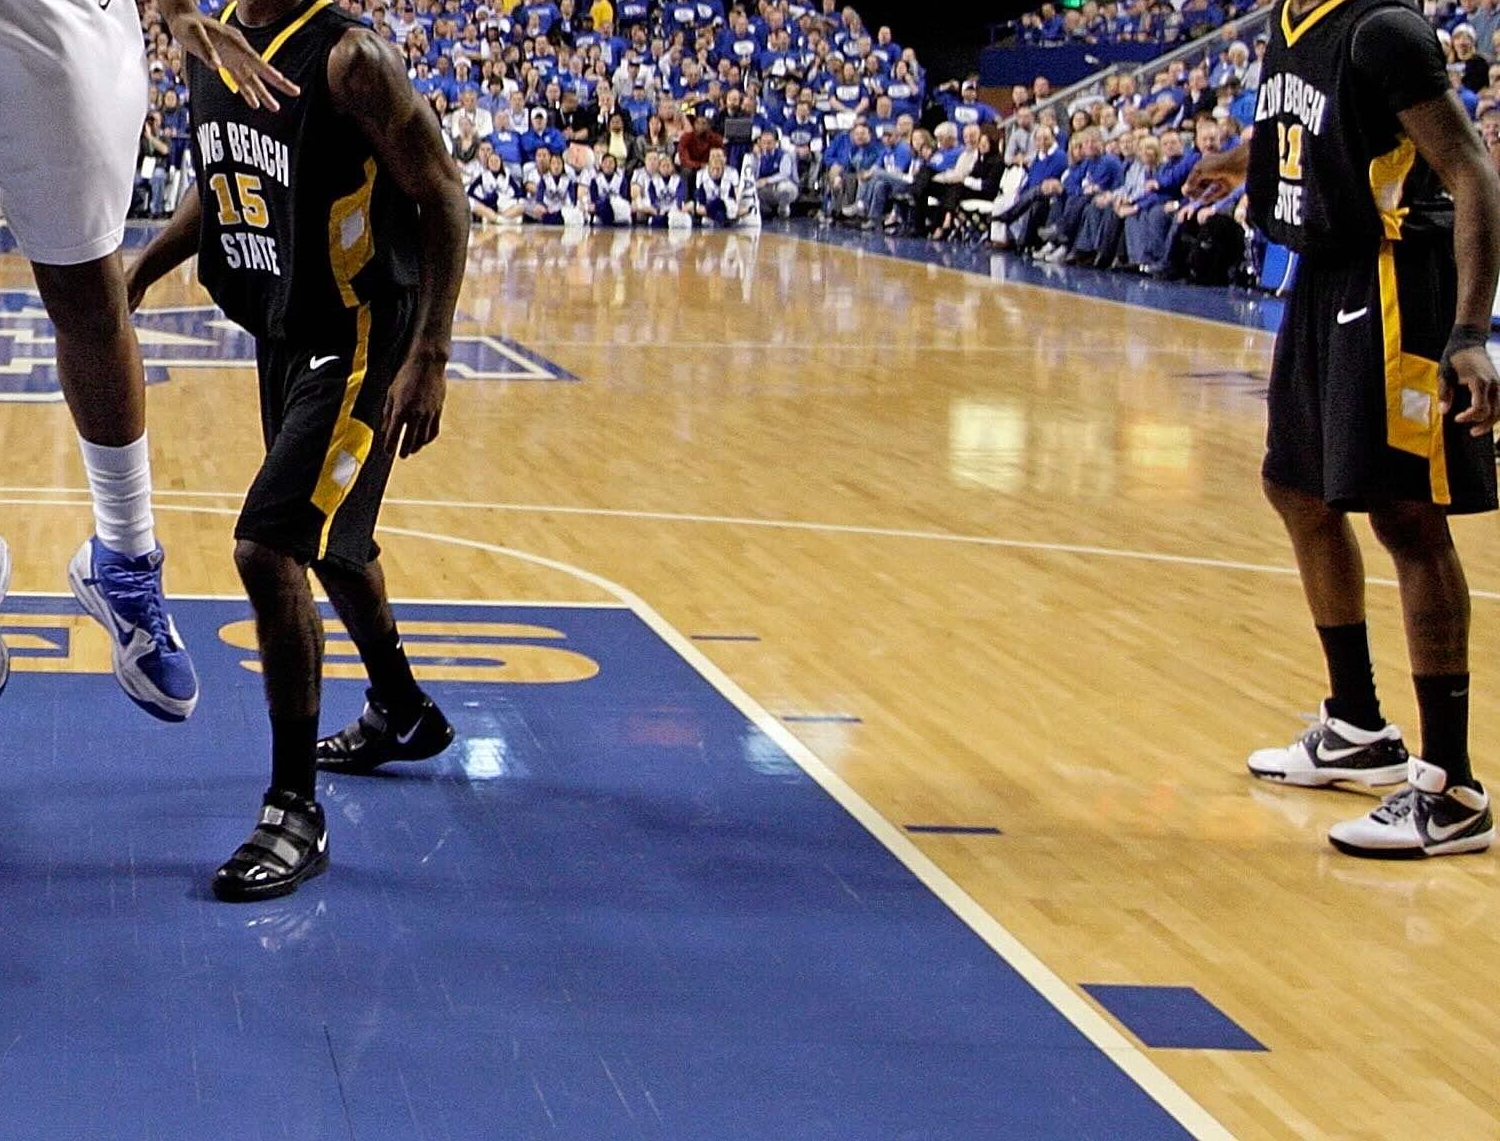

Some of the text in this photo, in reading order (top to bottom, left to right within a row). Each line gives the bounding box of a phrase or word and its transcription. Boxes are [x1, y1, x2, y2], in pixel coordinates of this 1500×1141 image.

[226, 121, 290, 188] BEACH
[209, 172, 270, 229] 15
[220, 232, 282, 277] STATE
